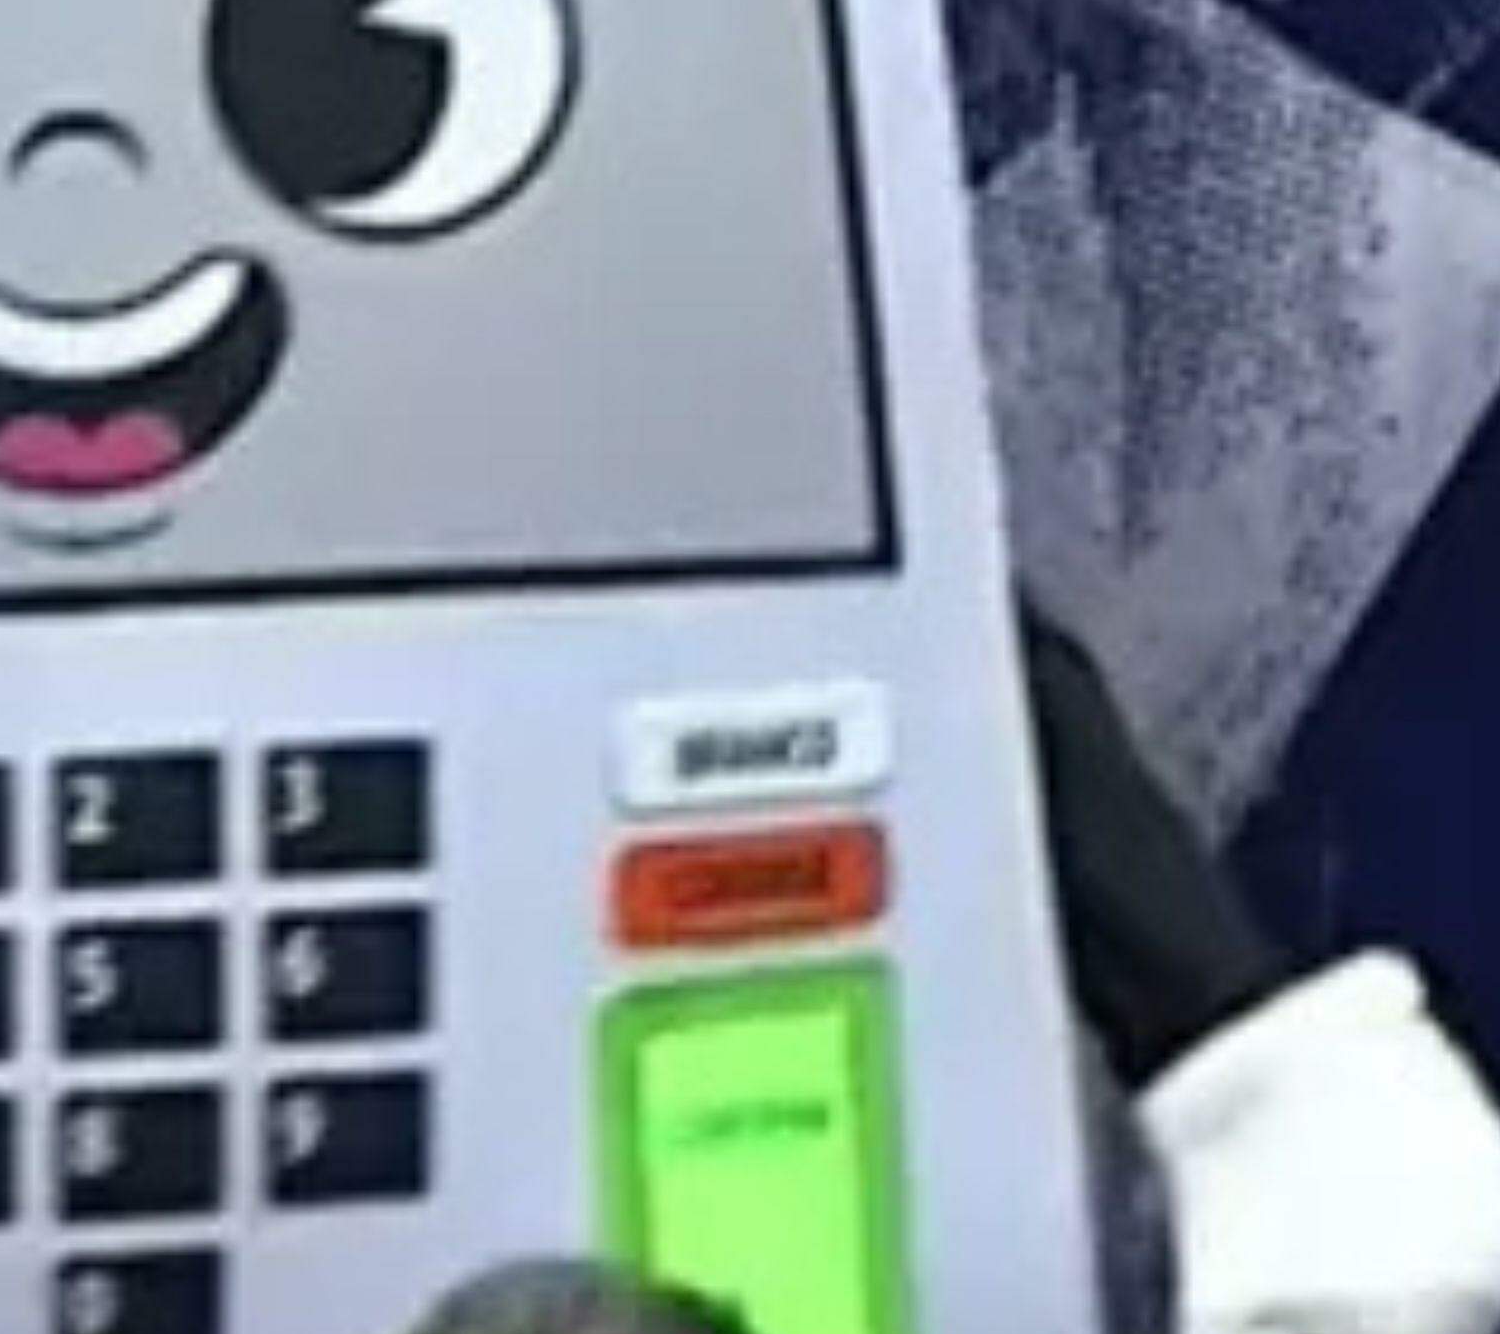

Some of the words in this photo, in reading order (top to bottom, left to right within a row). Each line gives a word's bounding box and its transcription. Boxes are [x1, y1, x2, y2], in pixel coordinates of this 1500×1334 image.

[63, 771, 118, 847] 2
[273, 753, 324, 836] 3
[63, 937, 118, 1013] 5
[273, 924, 327, 1001] 6
[64, 1105, 118, 1179] 8
[273, 1092, 327, 1165] 9
